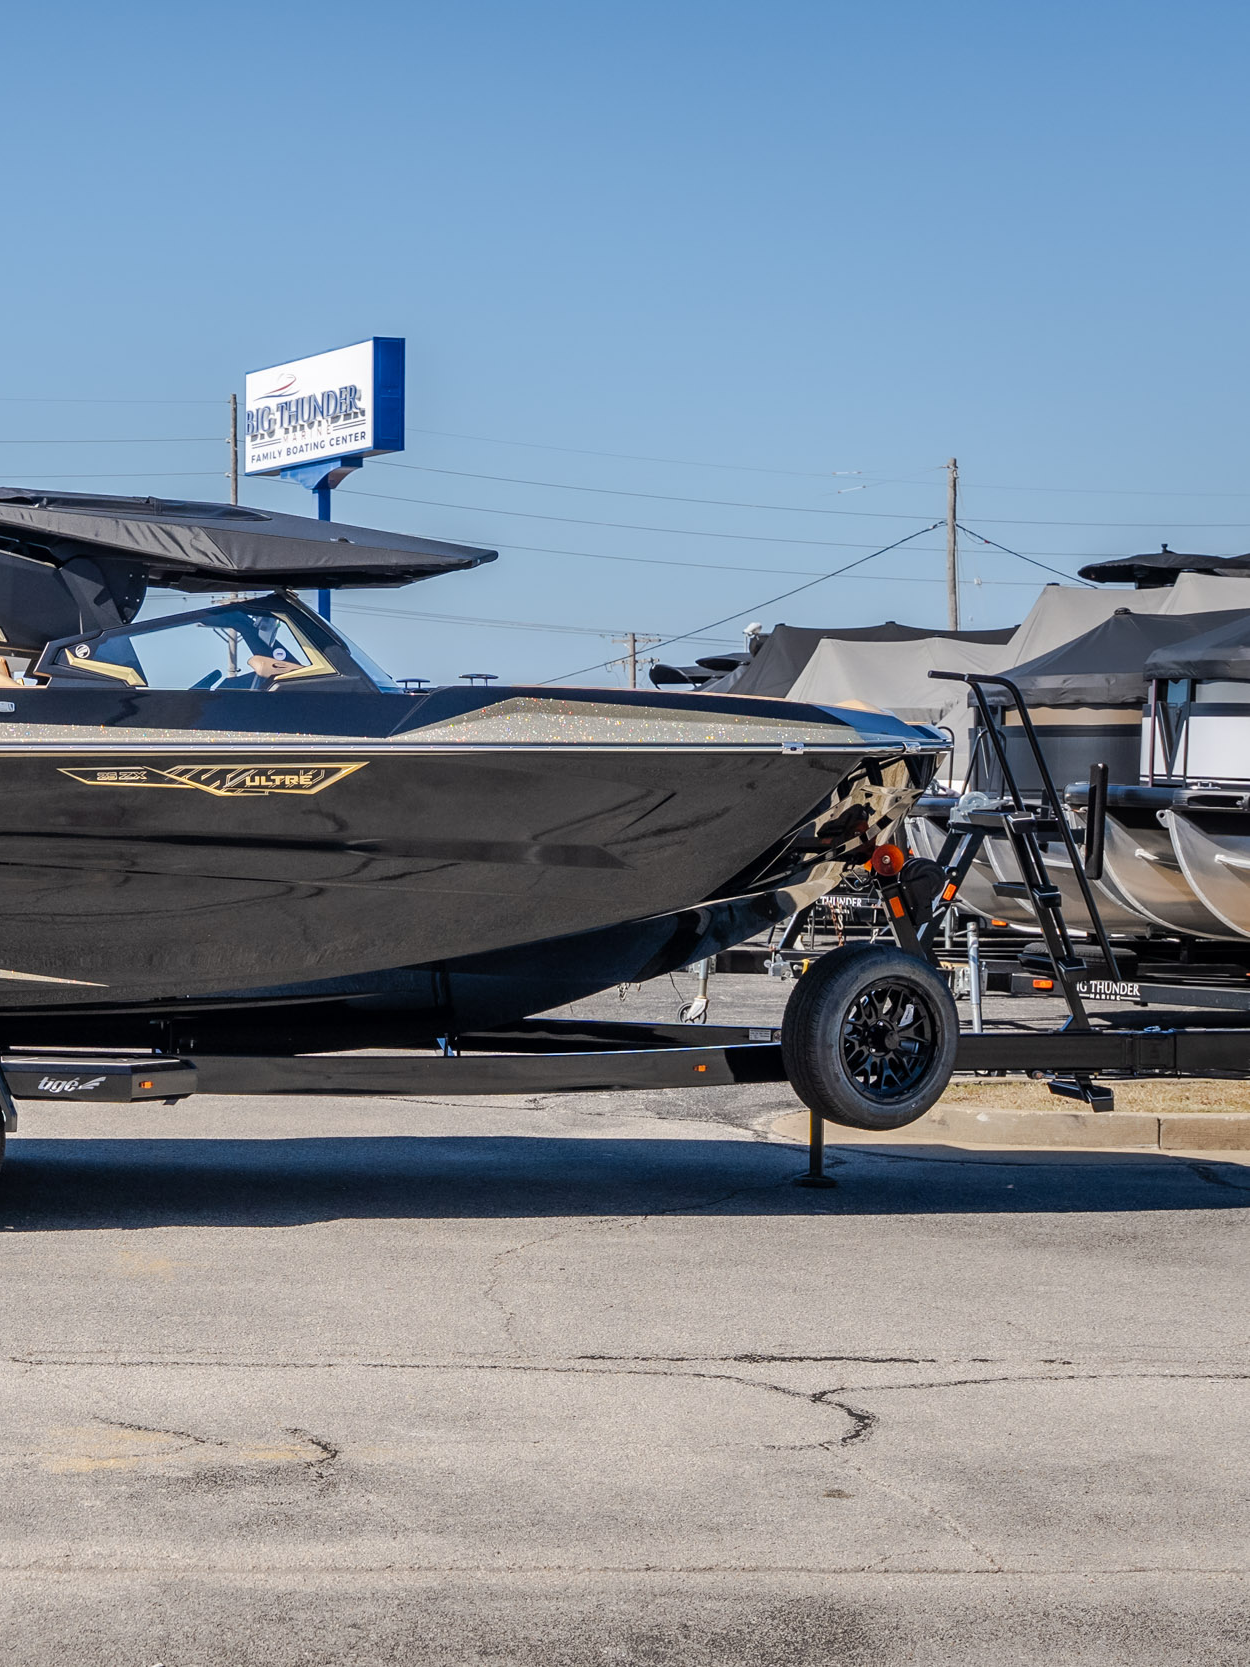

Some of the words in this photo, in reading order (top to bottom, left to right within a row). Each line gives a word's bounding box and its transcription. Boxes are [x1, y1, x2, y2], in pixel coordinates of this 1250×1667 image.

[246, 405, 272, 435] BIG
[276, 384, 361, 428] THUNDER
[283, 423, 331, 443] MARINE
[251, 449, 282, 463] FAMILY
[286, 440, 326, 456] BOATING
[329, 431, 367, 447] CENTER
[118, 771, 147, 781] ZX
[820, 895, 862, 907] THUNDER
[1090, 980, 1141, 996] THUNDER
[1090, 993, 1121, 1001] MARINE
